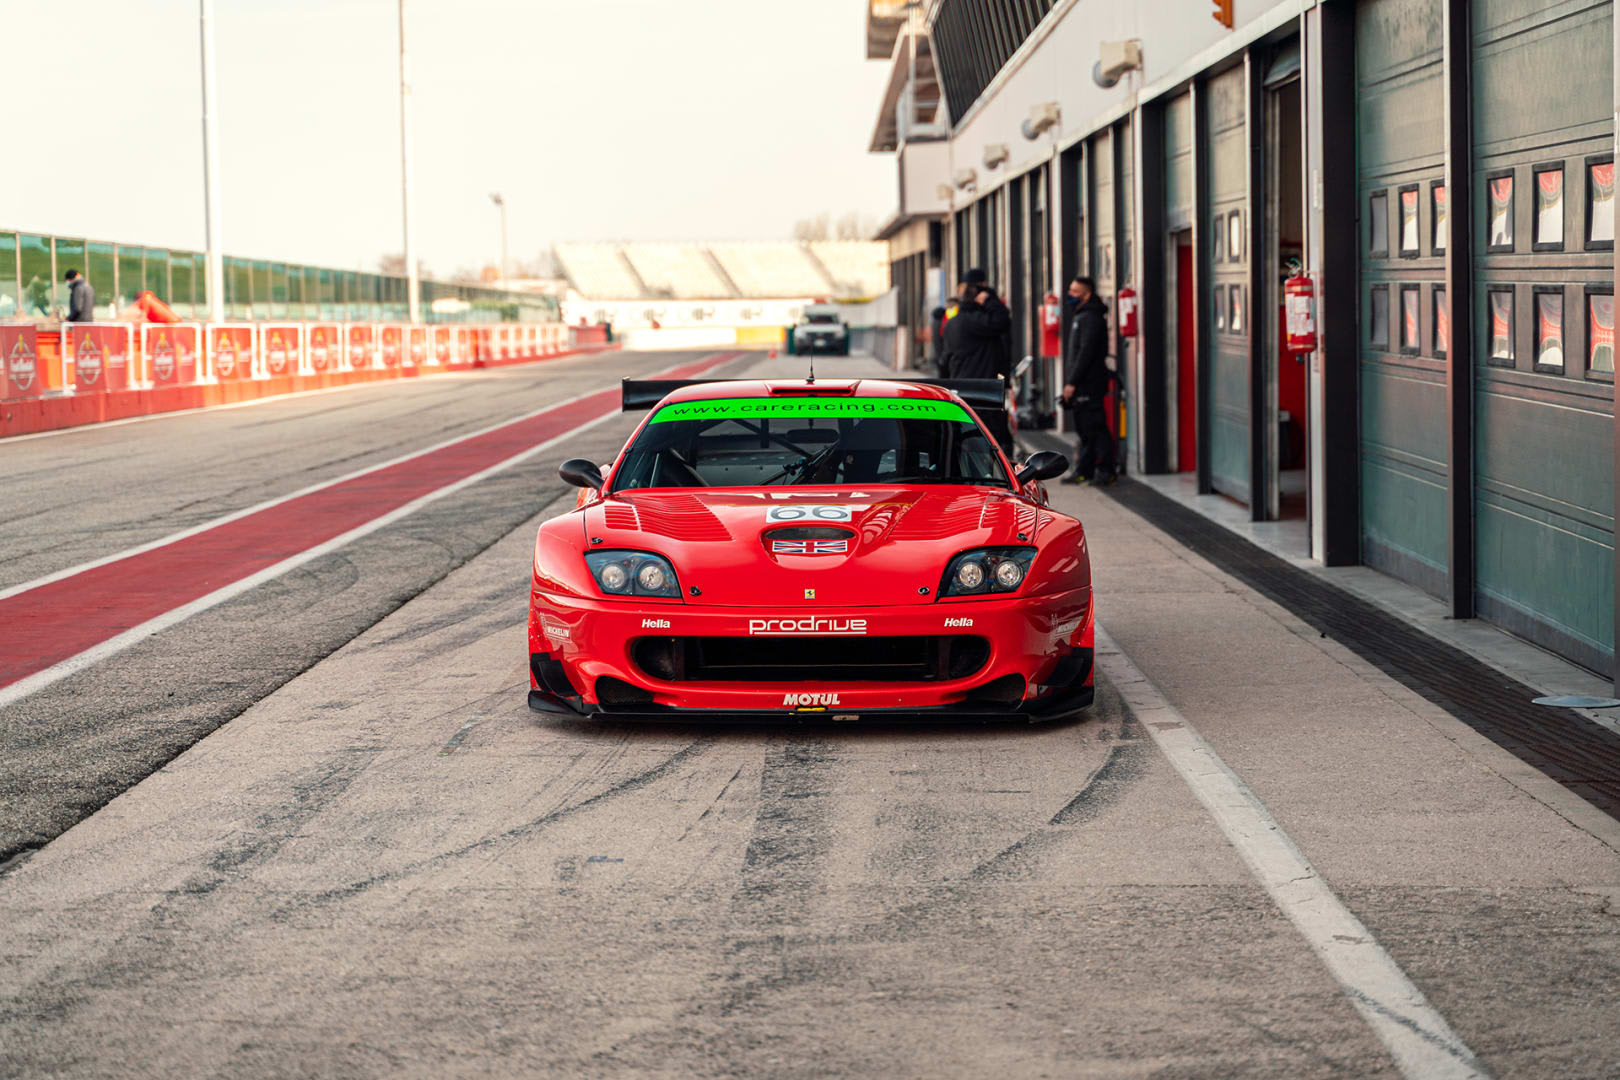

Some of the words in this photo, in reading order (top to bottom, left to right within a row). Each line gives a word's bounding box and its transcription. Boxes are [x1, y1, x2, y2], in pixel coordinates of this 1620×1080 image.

[673, 402, 937, 414] www.careracing.com
[770, 506, 848, 520] 66
[641, 618, 671, 629] Hella
[749, 615, 867, 635] prodrive
[944, 617, 974, 628] Hella
[782, 693, 841, 706] MOTUL
